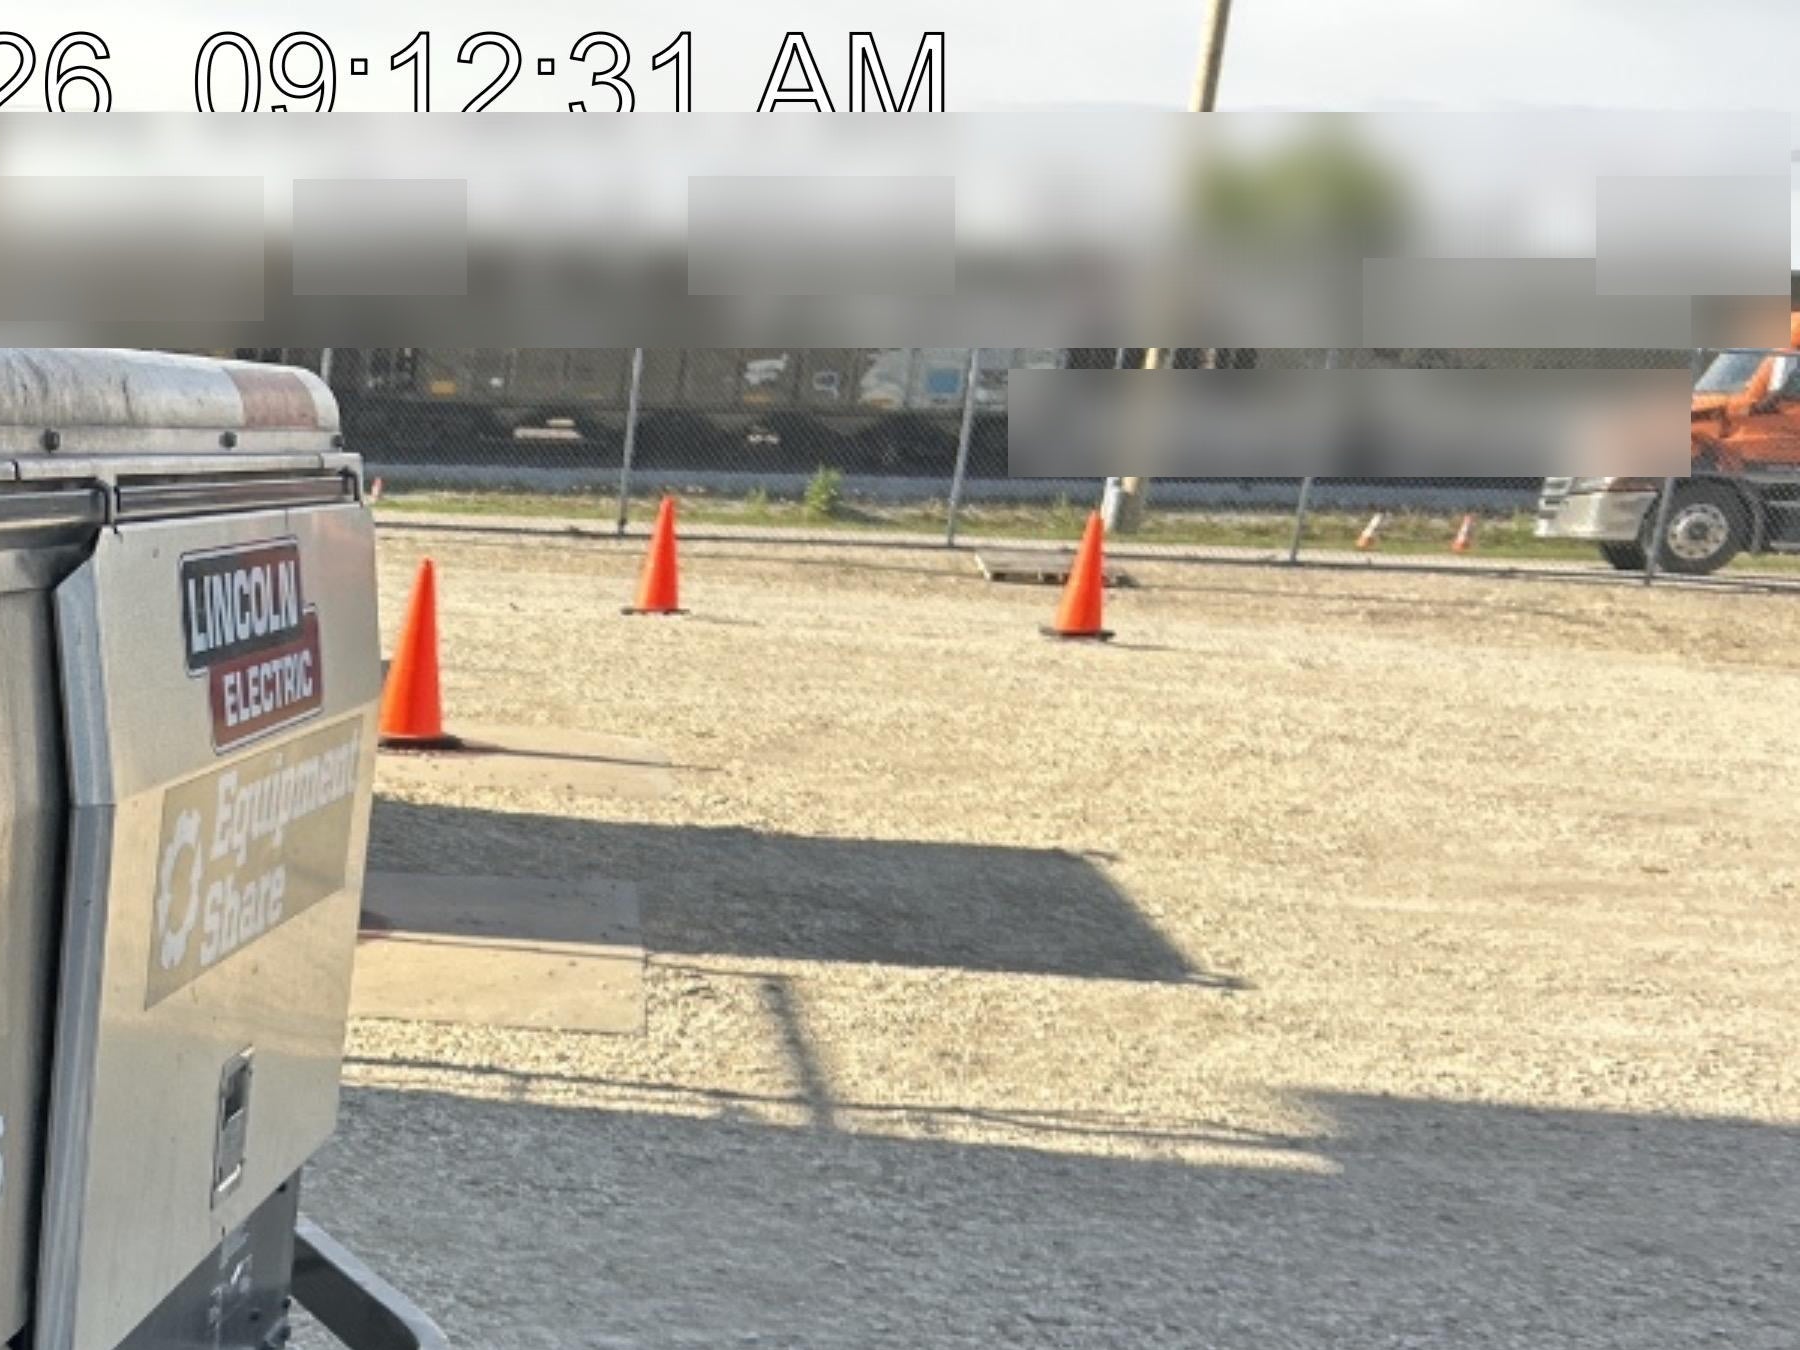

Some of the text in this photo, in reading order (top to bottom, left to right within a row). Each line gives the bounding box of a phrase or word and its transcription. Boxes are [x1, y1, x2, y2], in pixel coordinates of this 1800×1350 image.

[186, 560, 298, 654] LINCOLN
[223, 648, 313, 728] ELECTRIC
[210, 728, 360, 868] Equipment
[200, 864, 287, 968] Share
